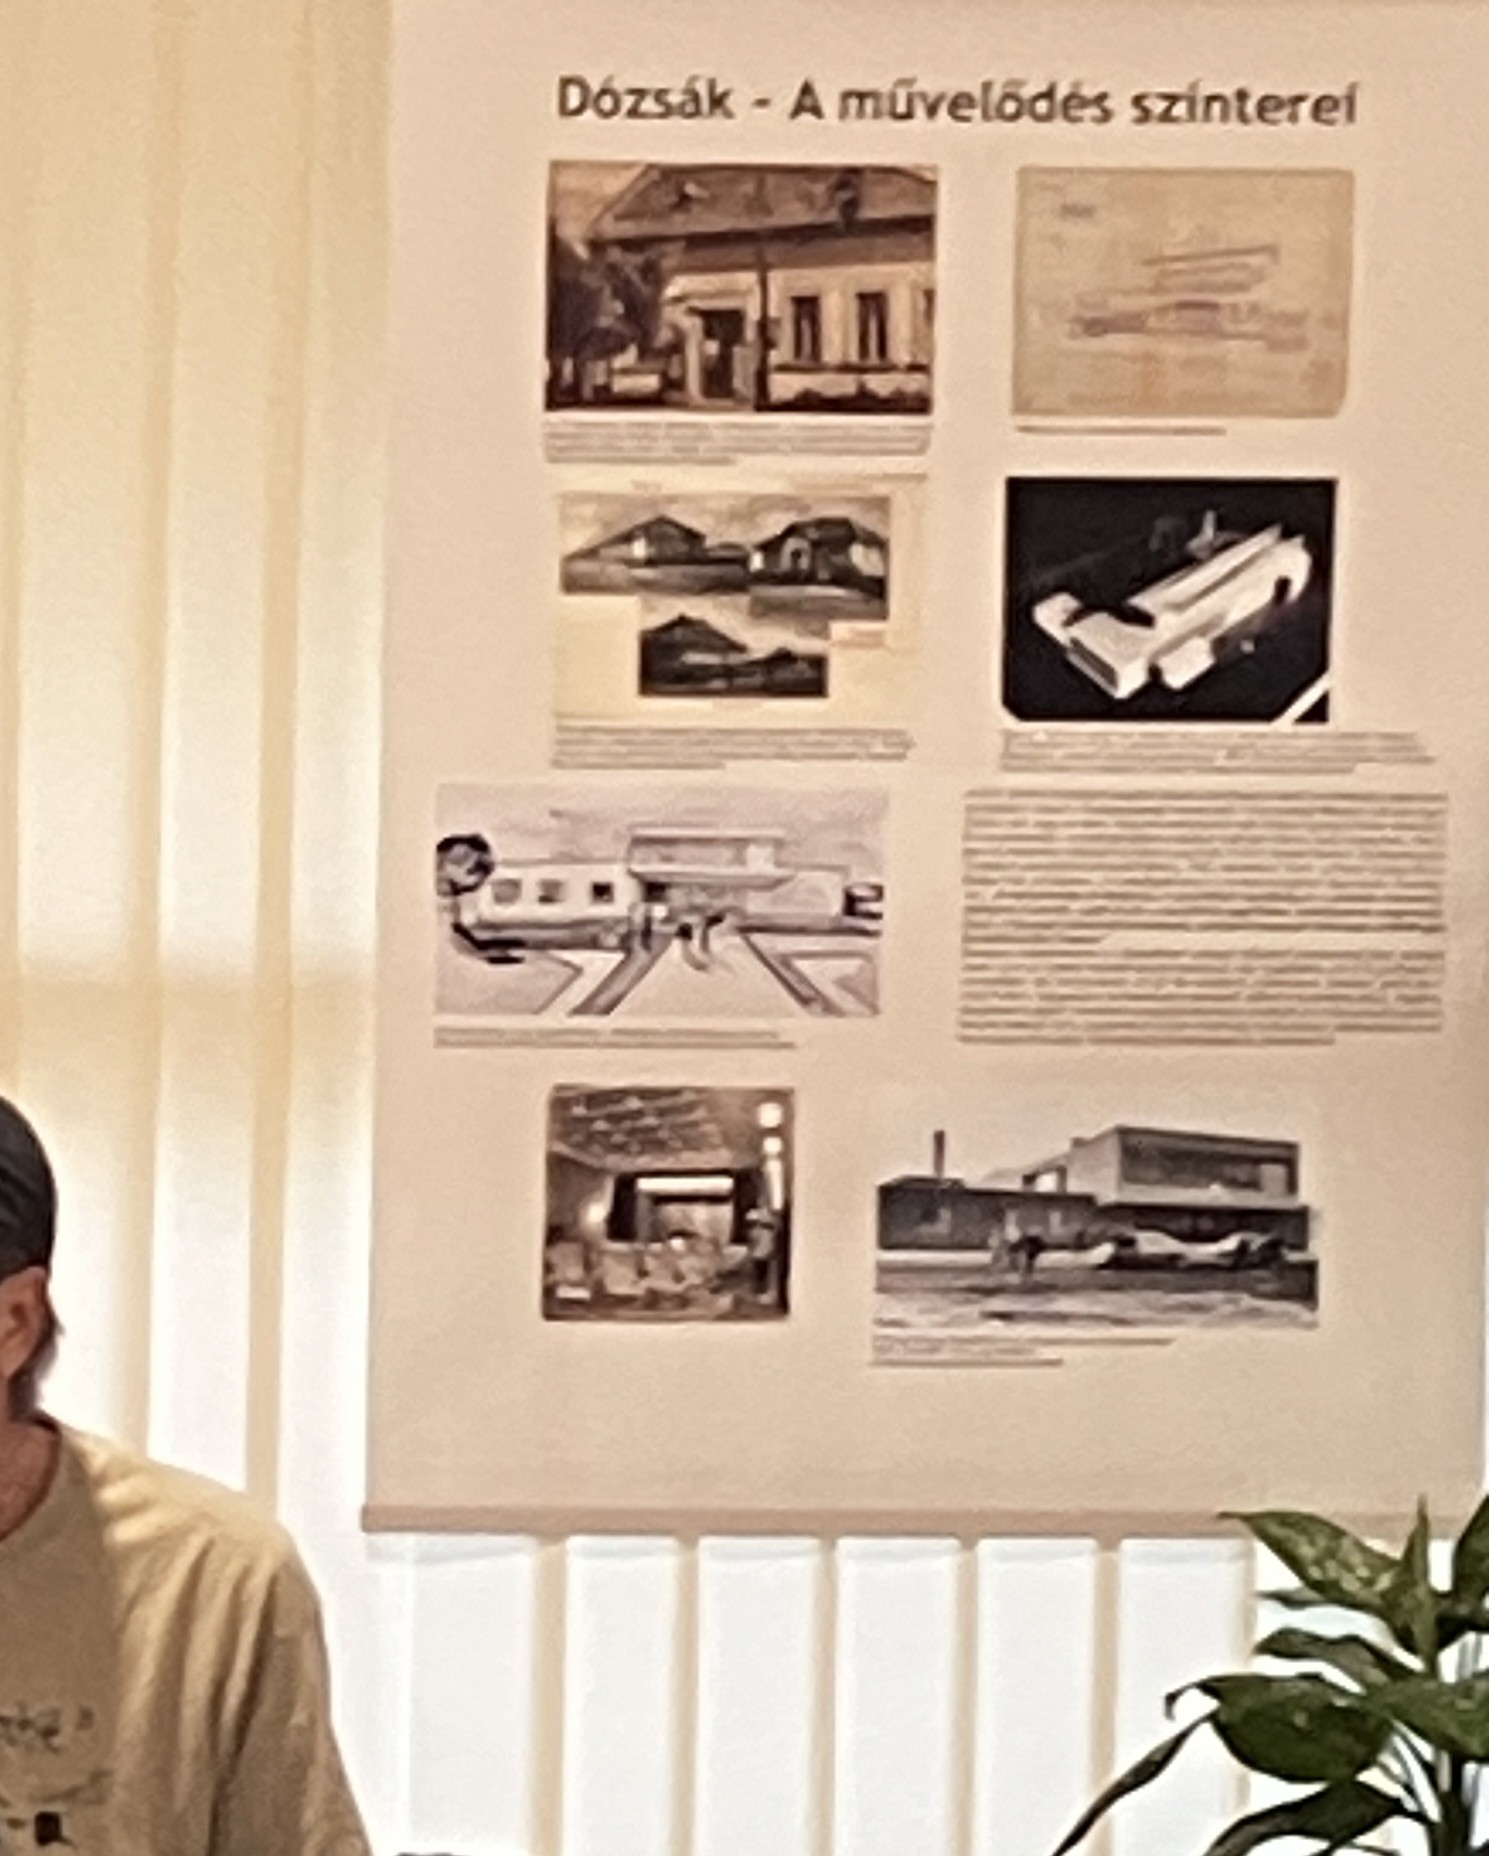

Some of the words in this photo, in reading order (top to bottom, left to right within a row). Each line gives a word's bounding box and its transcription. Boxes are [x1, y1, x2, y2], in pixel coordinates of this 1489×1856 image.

[557, 74, 735, 121] Dózsák
[788, 78, 825, 121] A
[837, 76, 1113, 124] művelődés
[1130, 78, 1361, 125] színterei
